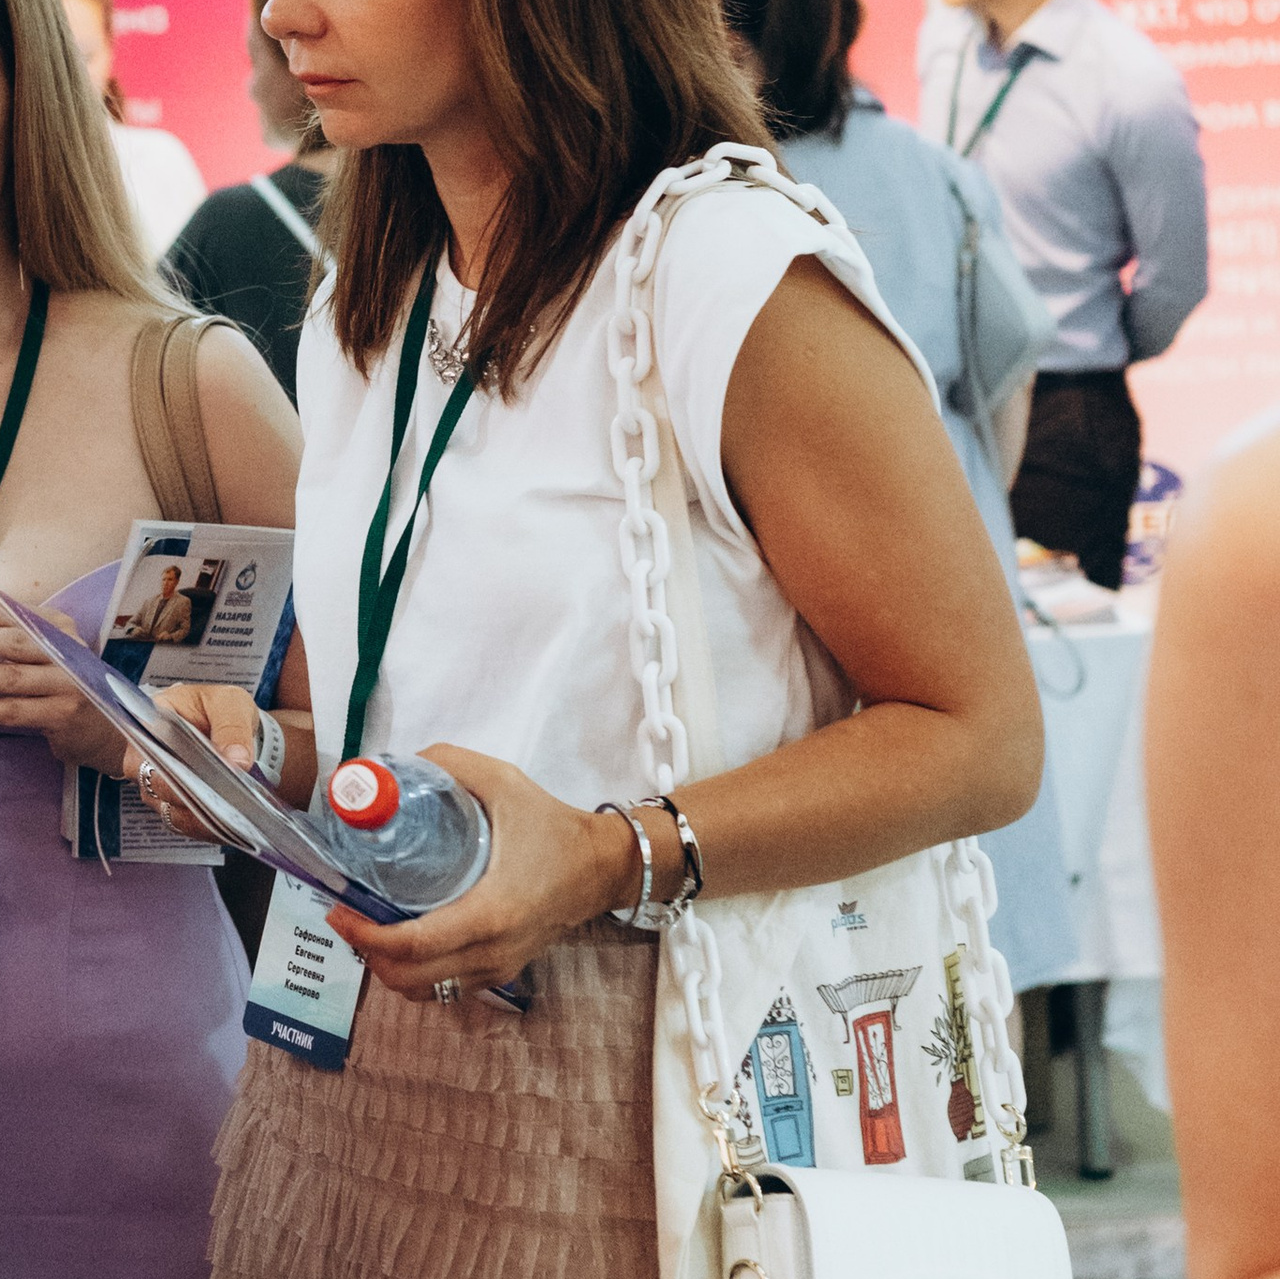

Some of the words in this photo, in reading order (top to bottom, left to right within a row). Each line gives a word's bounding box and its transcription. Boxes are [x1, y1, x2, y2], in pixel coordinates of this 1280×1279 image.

[214, 611, 253, 622] НАЗАРОВ
[210, 625, 254, 636] Александр
[293, 925, 334, 949] Сафронова
[295, 944, 325, 964] Евгения
[287, 961, 325, 983] Сергеевна
[283, 978, 320, 1000] Кемерово
[271, 1020, 314, 1051] УЧАСТНИК
